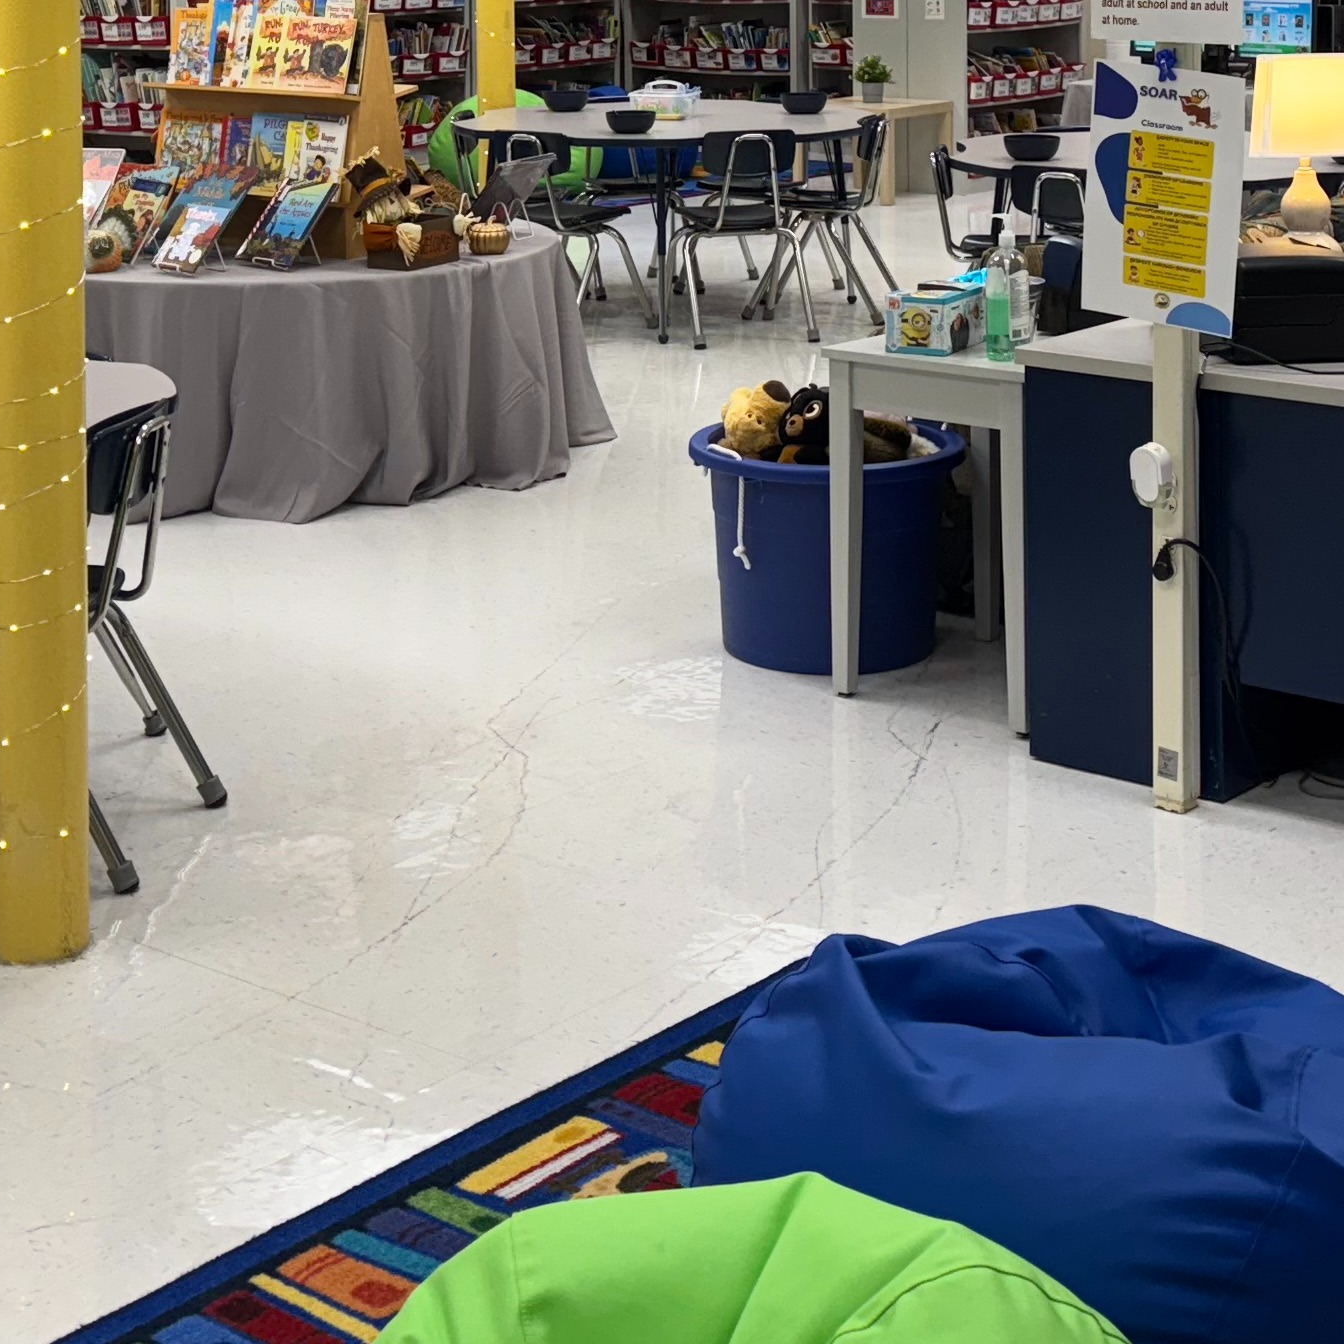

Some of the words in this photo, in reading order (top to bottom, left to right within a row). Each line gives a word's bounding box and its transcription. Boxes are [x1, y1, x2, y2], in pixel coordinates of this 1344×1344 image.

[1138, 0, 1168, 9] school
[1171, 0, 1187, 10] and
[1190, 2, 1201, 10] an
[1204, 1, 1228, 11] adult
[1102, 15, 1110, 24] at
[1139, 85, 1178, 101] SOAR
[1141, 119, 1184, 132] Classroom
